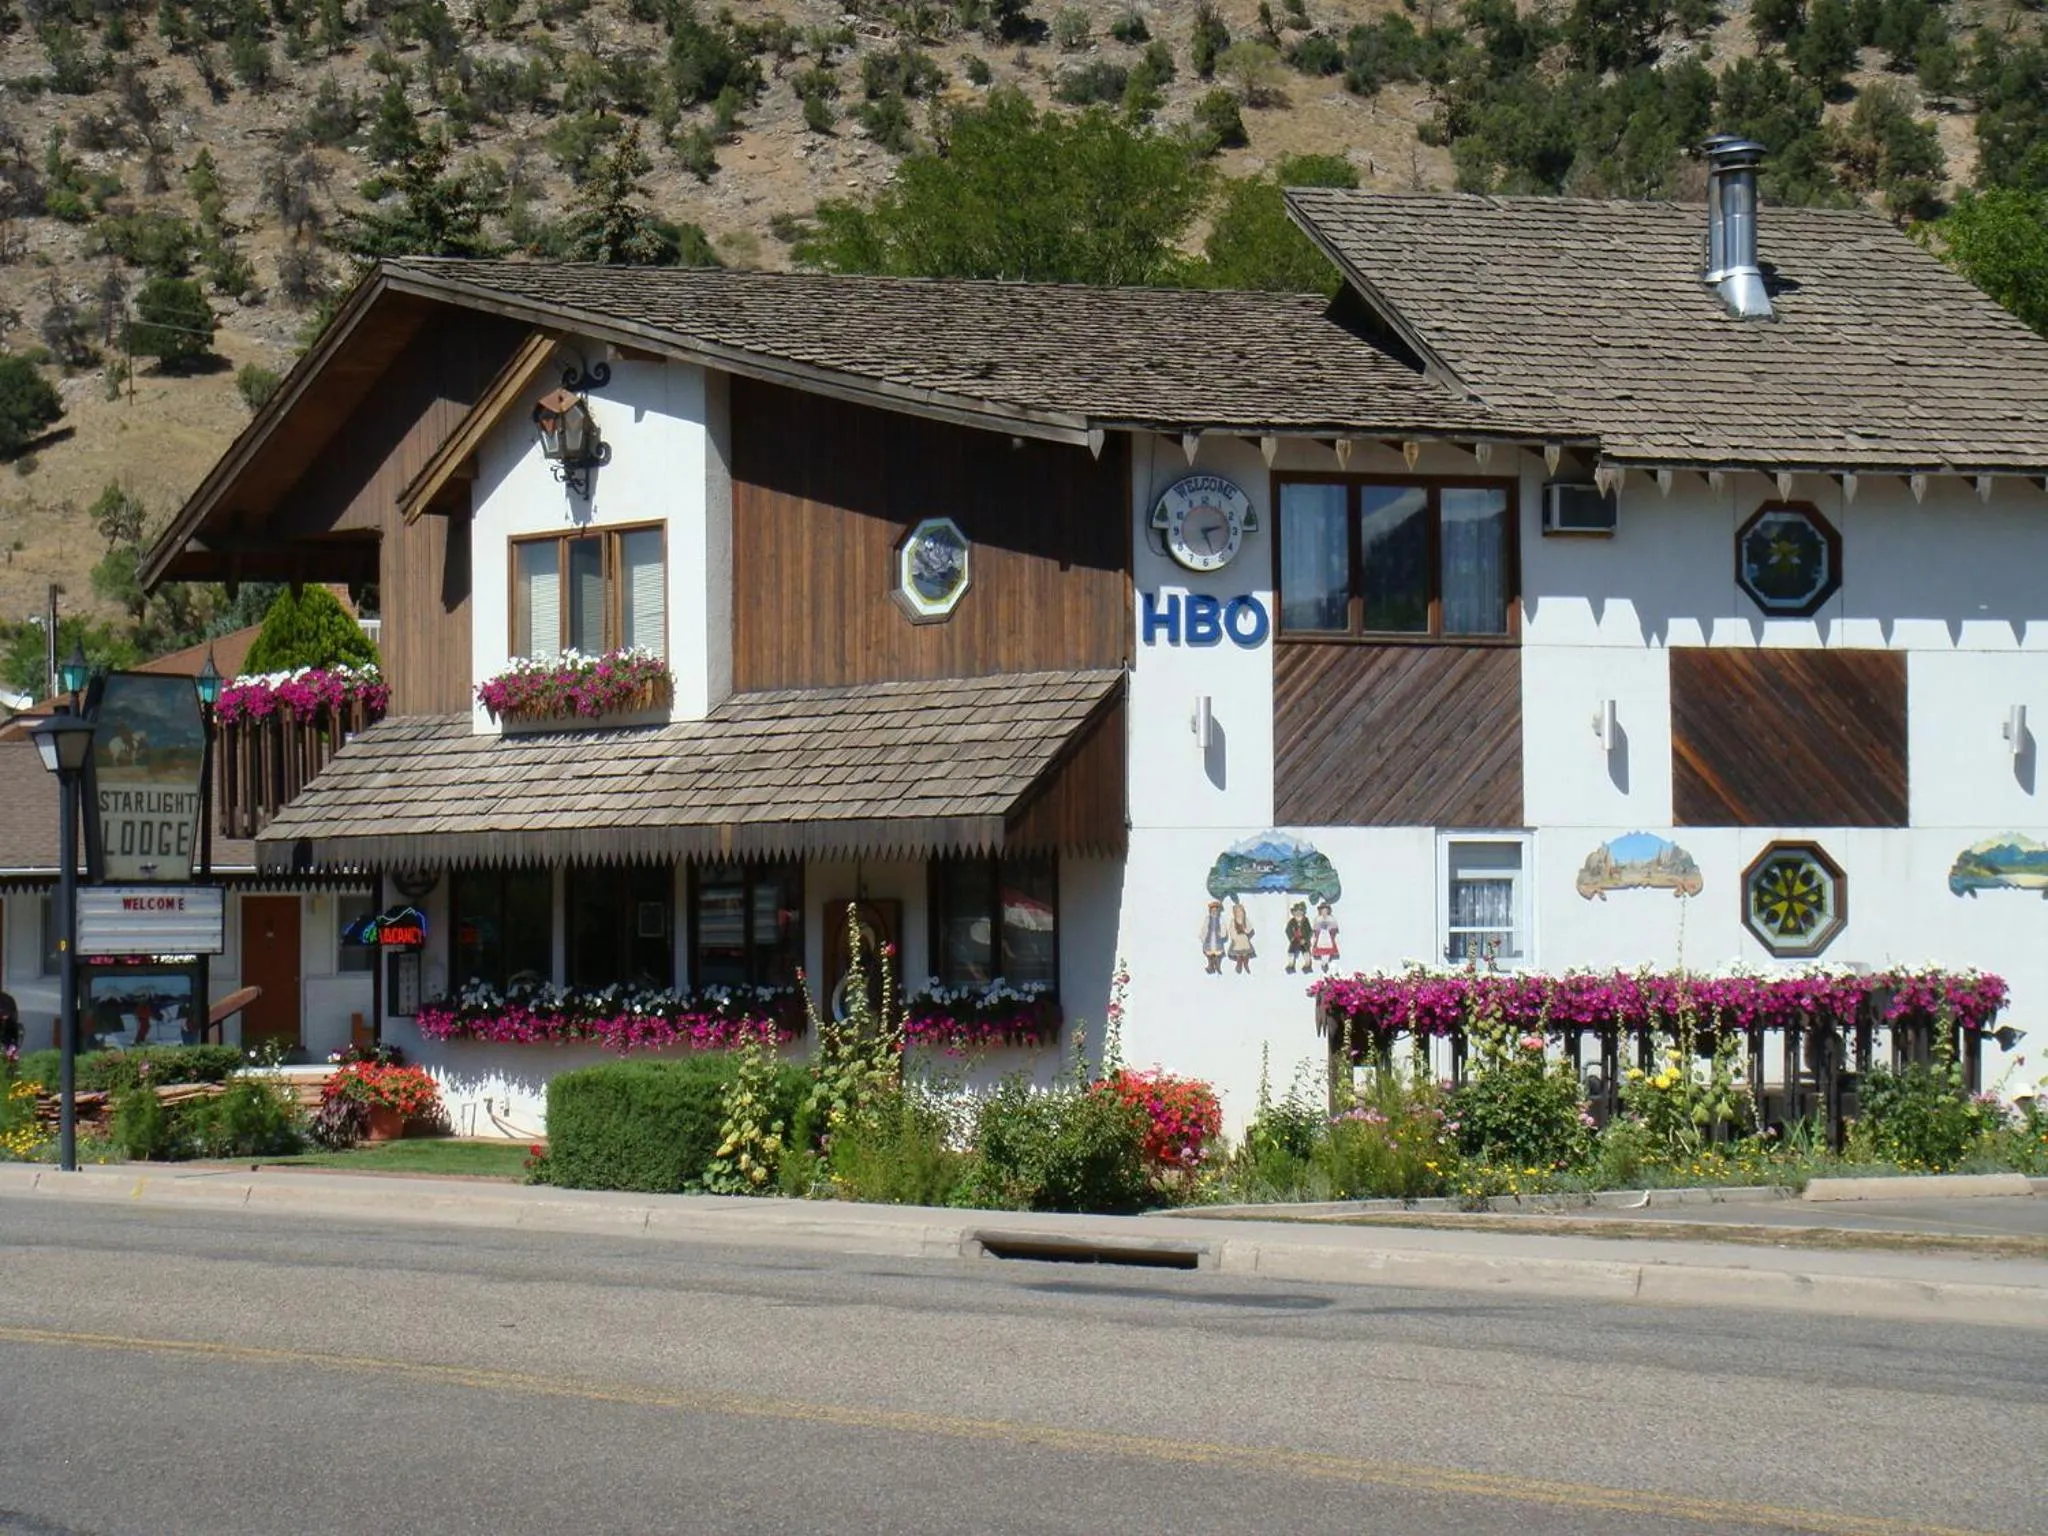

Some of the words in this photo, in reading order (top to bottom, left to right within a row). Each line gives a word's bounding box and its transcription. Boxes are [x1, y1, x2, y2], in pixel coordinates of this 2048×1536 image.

[1174, 478, 1237, 500] WELCOME
[1143, 593, 1270, 648] HBO
[99, 791, 198, 813] STARLIGHT
[104, 820, 189, 856] LODGE
[122, 896, 185, 911] WELCOME
[379, 926, 422, 944] VACANCY
